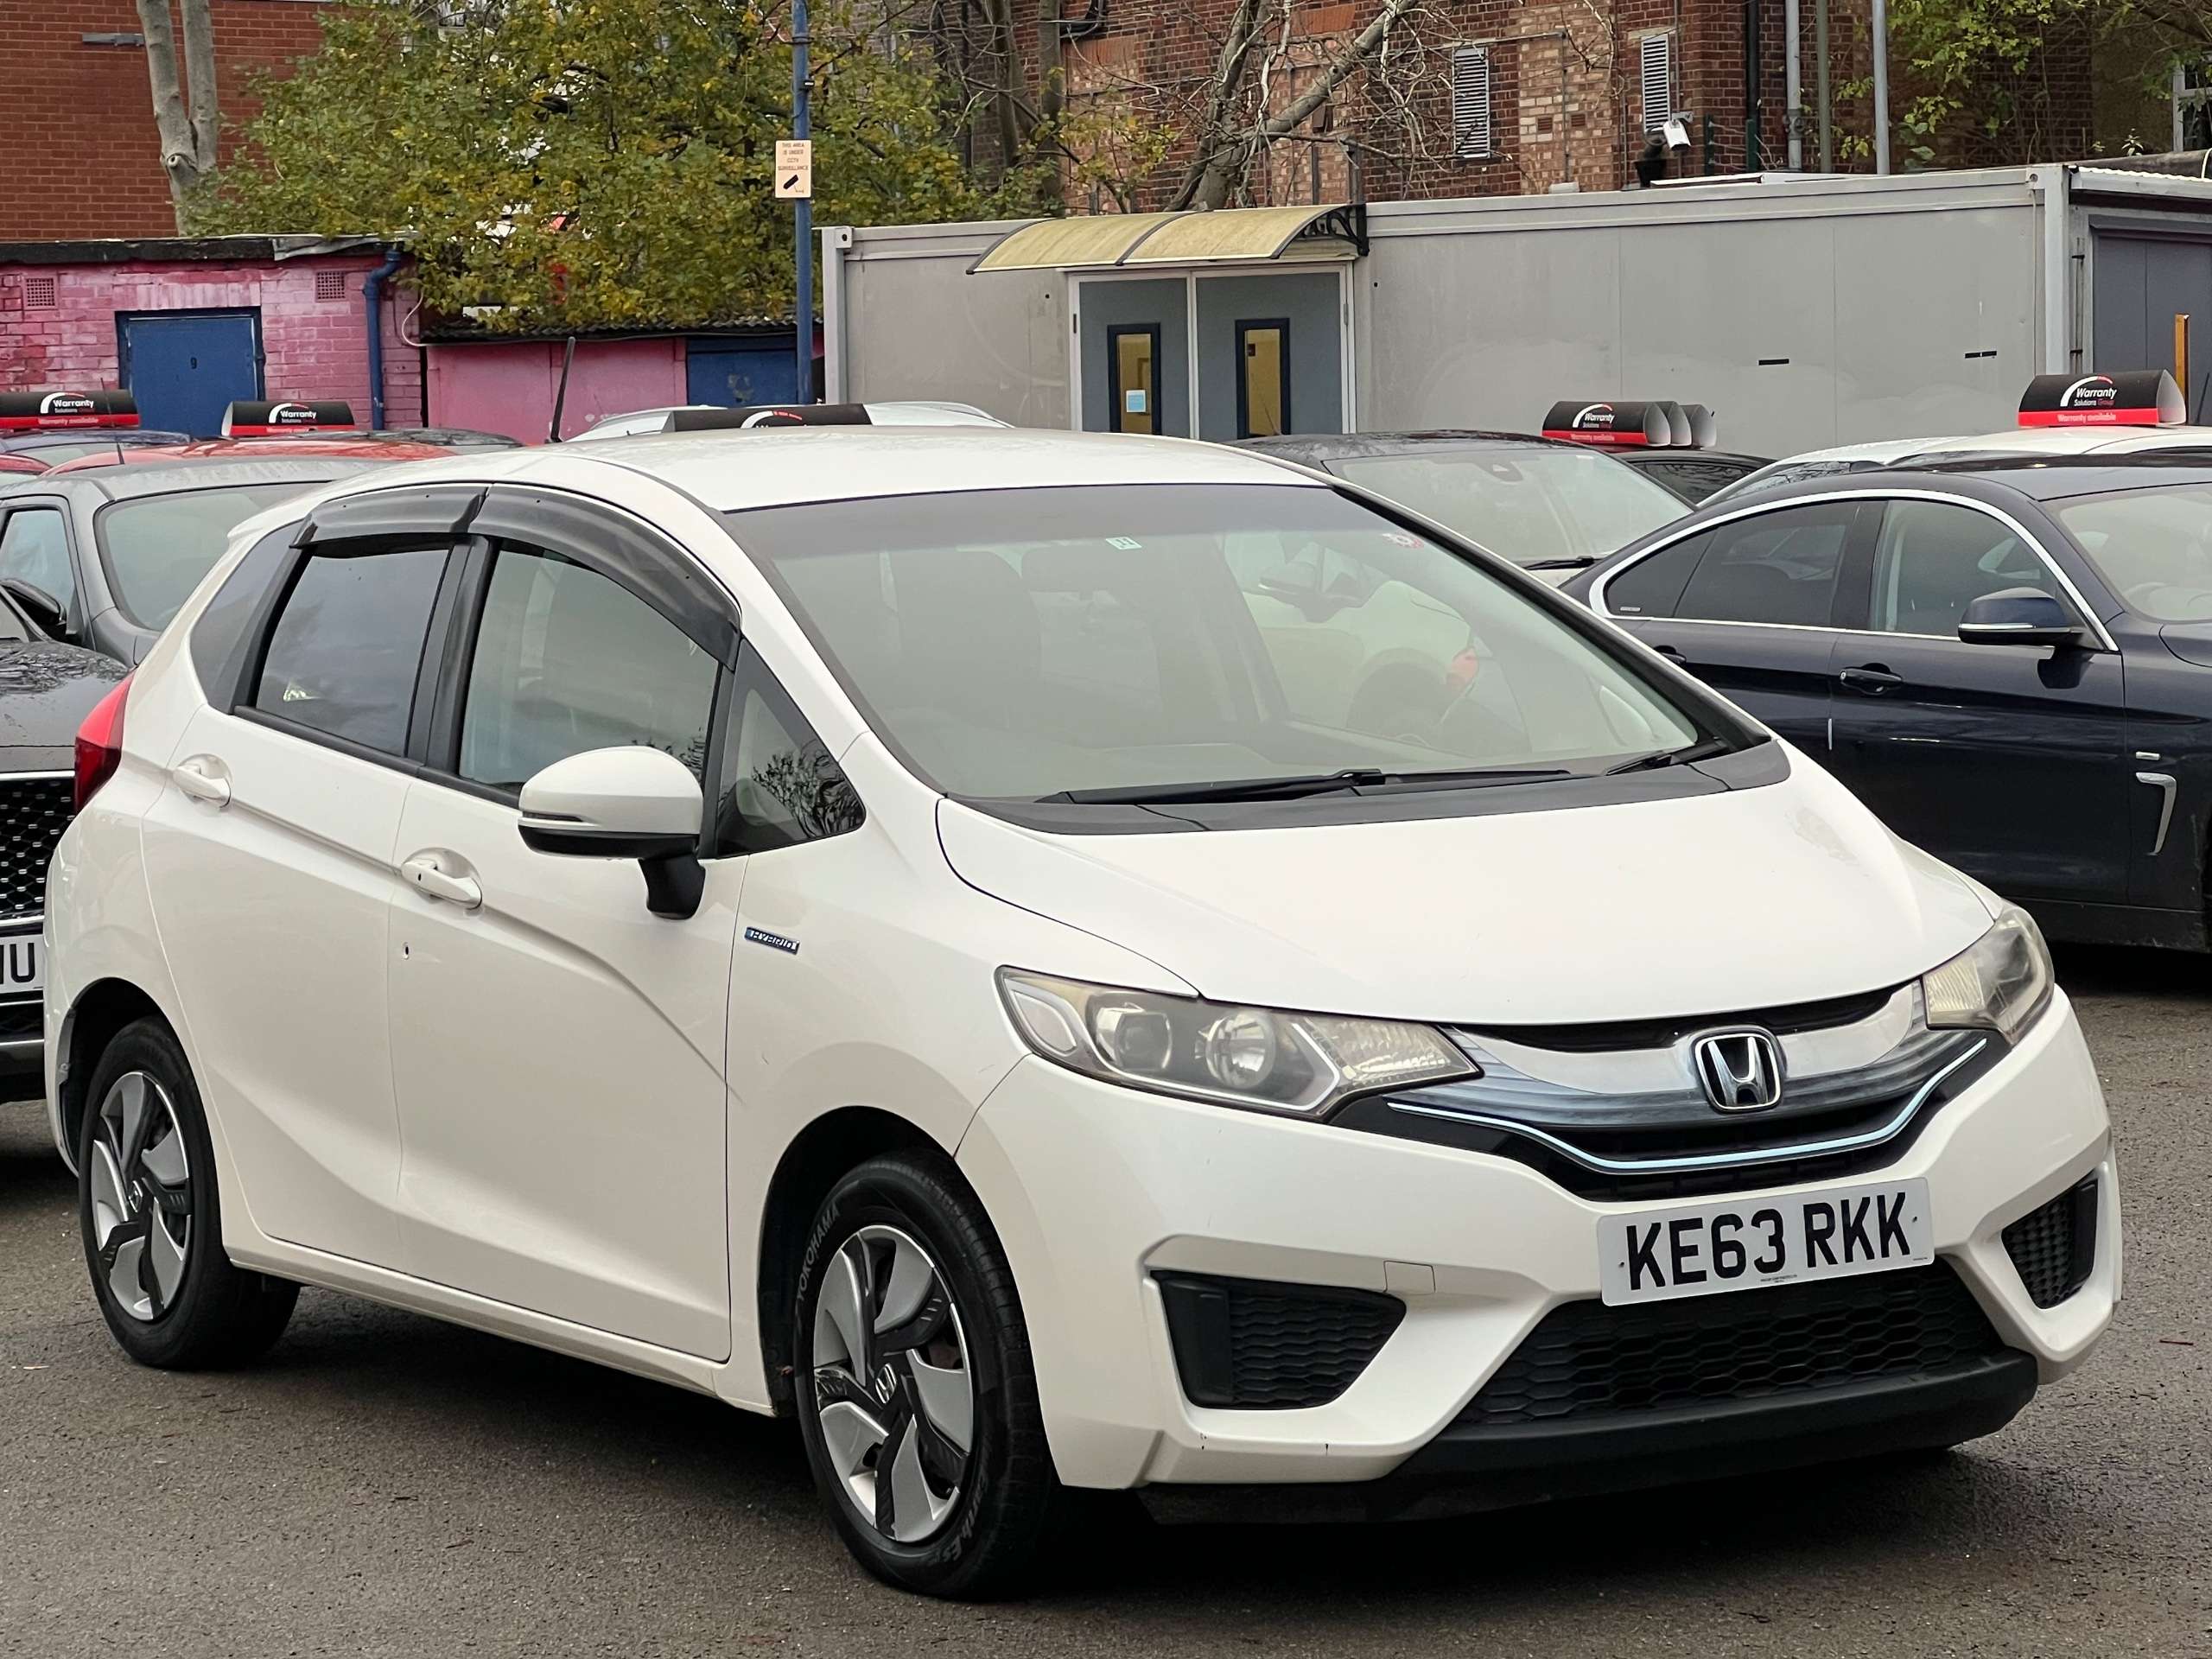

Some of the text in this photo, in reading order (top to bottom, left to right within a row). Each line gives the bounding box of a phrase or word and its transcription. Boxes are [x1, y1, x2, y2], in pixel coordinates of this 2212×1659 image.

[2075, 387, 2117, 399] Warranty
[53, 399, 94, 408] Warranty
[2074, 398, 2097, 407] Solutions
[1585, 413, 1615, 423] Warranty
[2057, 414, 2087, 423] Warranty
[1625, 1192, 1910, 1291] KE63 RKK
